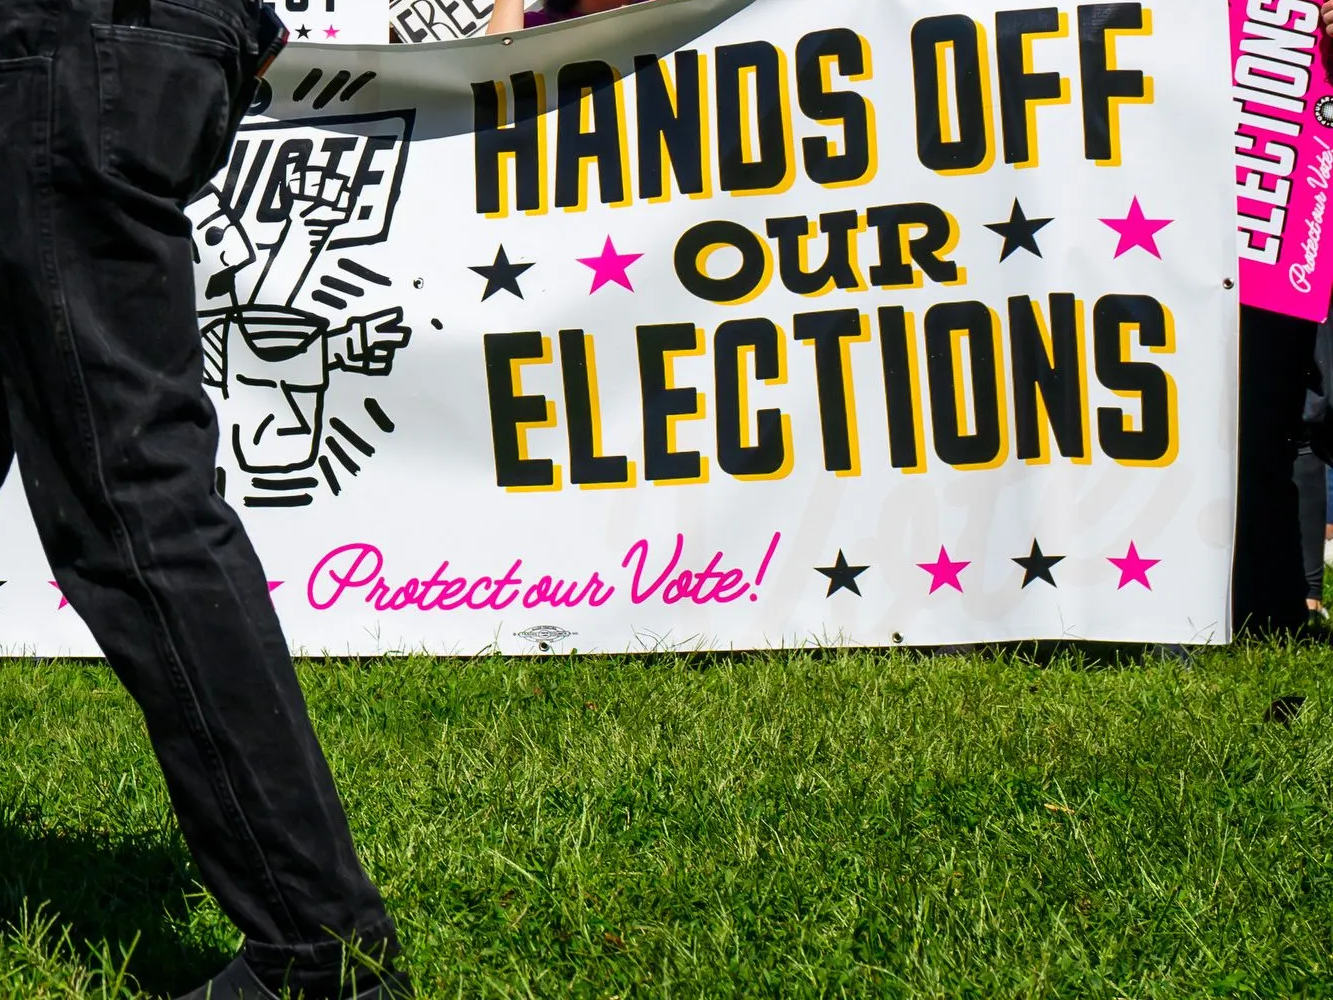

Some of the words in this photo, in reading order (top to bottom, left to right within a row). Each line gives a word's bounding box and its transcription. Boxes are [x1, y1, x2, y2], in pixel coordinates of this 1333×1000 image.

[472, 28, 874, 219] HANDS
[912, 2, 1153, 175] OFF
[674, 203, 964, 305] OUR
[1289, 220, 1321, 293] Protect
[1313, 190, 1327, 222] our
[484, 293, 1180, 491] ELECTIONS
[307, 543, 523, 612] Protect
[522, 569, 615, 608] our
[623, 532, 783, 605] Vote!
